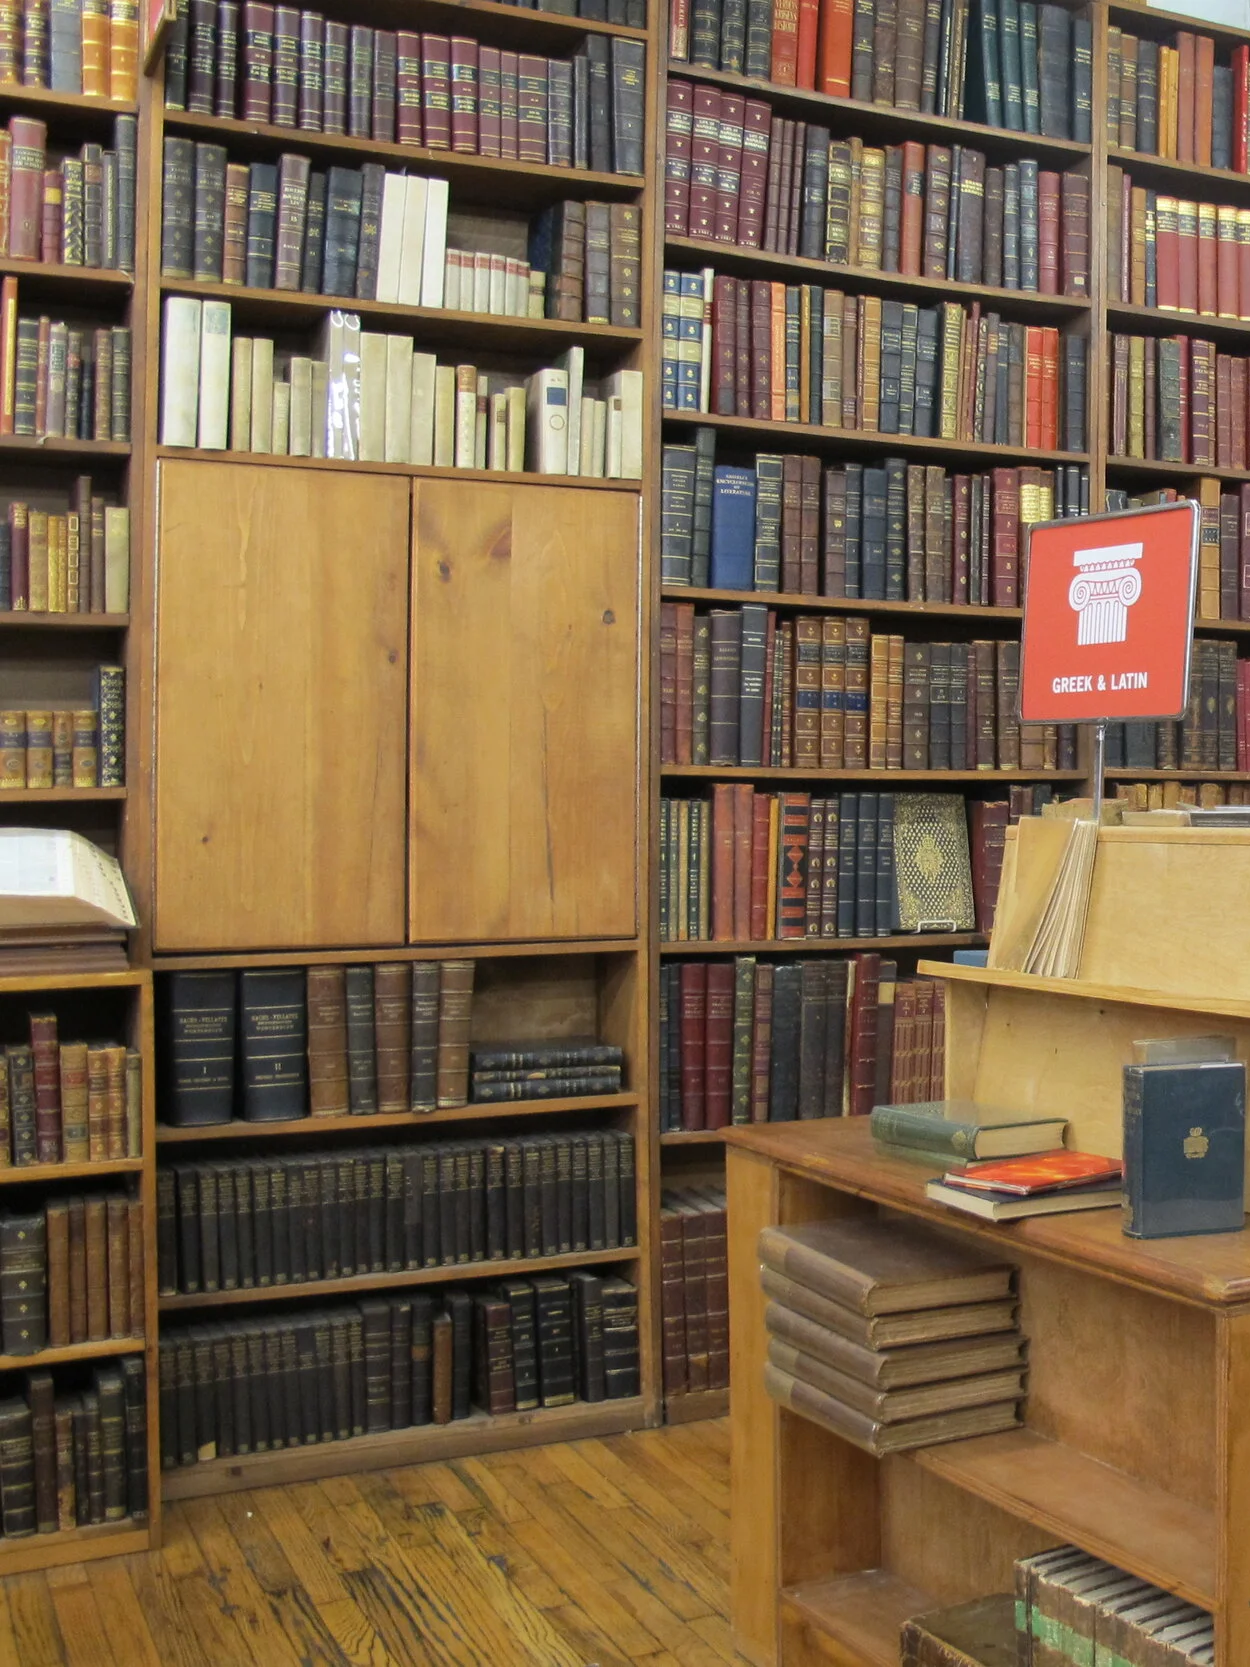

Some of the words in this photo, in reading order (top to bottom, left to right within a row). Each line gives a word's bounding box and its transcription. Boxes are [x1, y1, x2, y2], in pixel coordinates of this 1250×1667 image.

[1052, 675, 1093, 694] GREEK
[1097, 674, 1106, 691] &
[1111, 672, 1148, 690] LATIN
